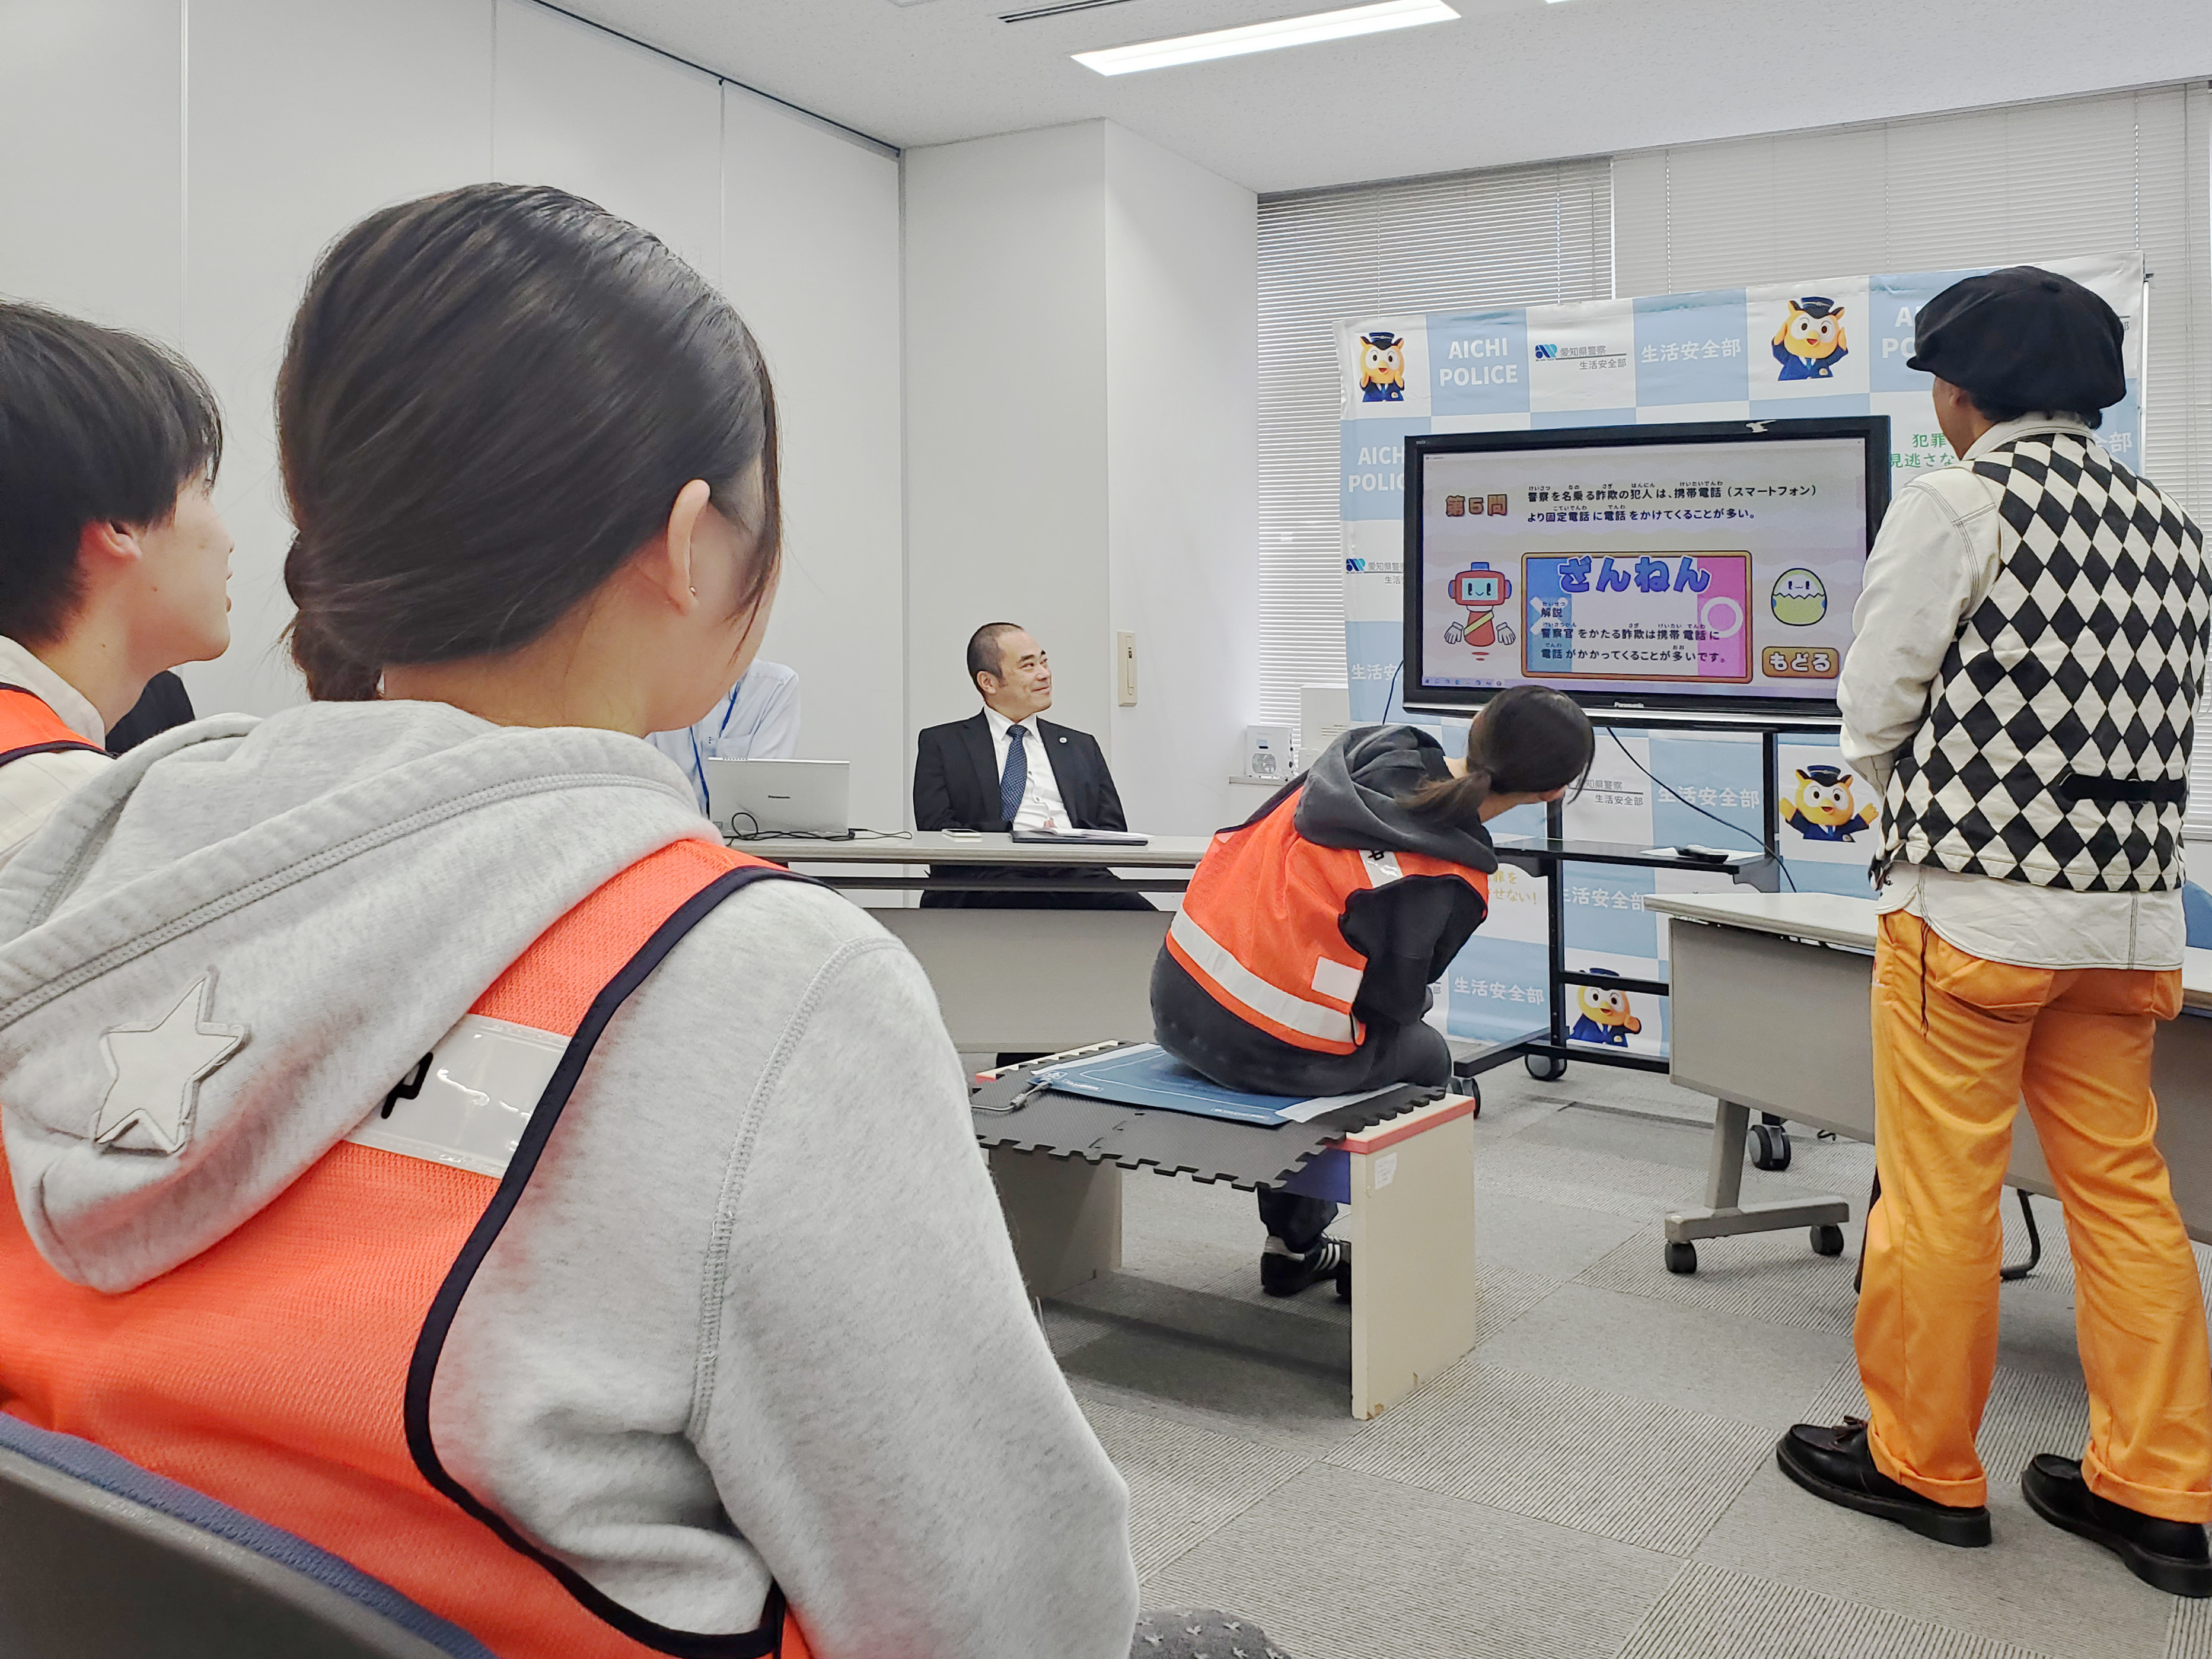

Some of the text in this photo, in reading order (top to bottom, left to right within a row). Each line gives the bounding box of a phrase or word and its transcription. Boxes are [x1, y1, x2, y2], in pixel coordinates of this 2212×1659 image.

[1449, 337, 1507, 359] AICHI
[1560, 346, 1607, 356] 愛知県警察
[1641, 338, 1741, 363] 生活安全部
[1440, 364, 1518, 386] POLICE
[1579, 358, 1627, 370] 生活安全部
[1445, 494, 1507, 517] 第5問
[1558, 556, 1711, 593] ざんねん
[1541, 607, 1563, 618] 解説
[1770, 652, 1831, 672] もどる
[1595, 794, 1643, 807] 生活安全部
[1658, 785, 1760, 809] 生活安全部
[1454, 976, 1545, 1005] 生活安全部
